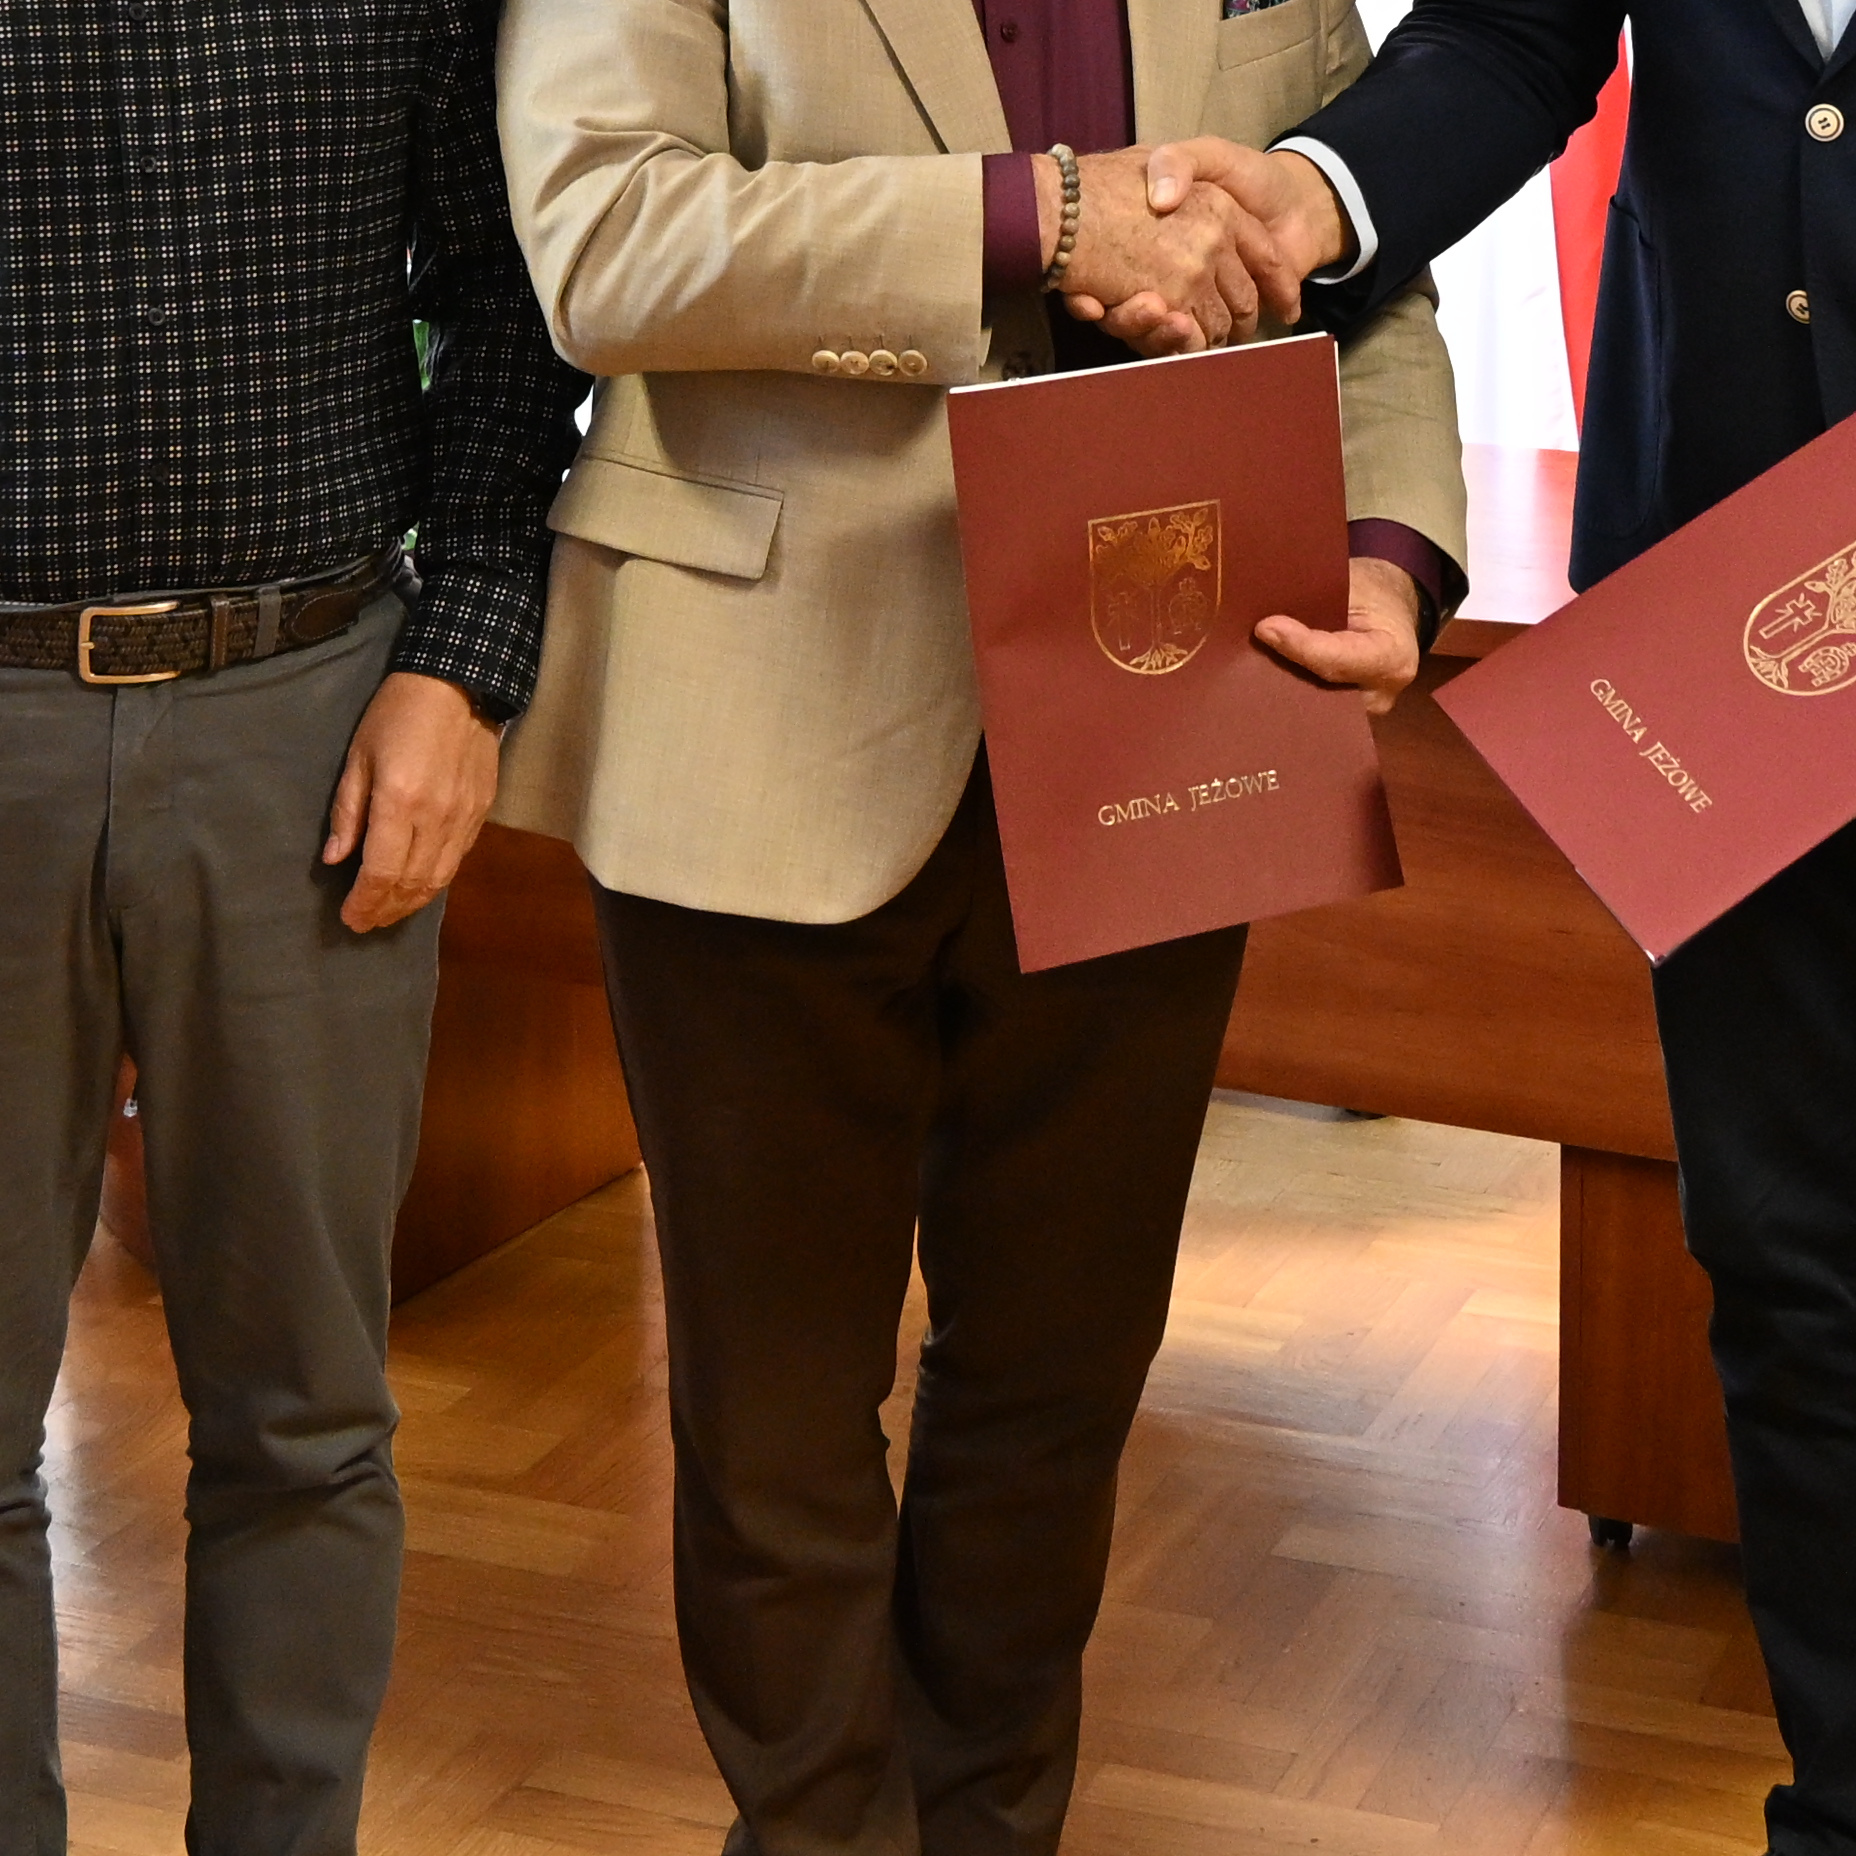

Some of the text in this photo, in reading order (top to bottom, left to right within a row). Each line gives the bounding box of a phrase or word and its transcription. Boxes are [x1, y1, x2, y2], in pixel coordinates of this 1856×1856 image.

[1589, 678, 1713, 814] GMINA JEŻOWE
[1097, 769, 1281, 827] GMINA JEŻOWE
